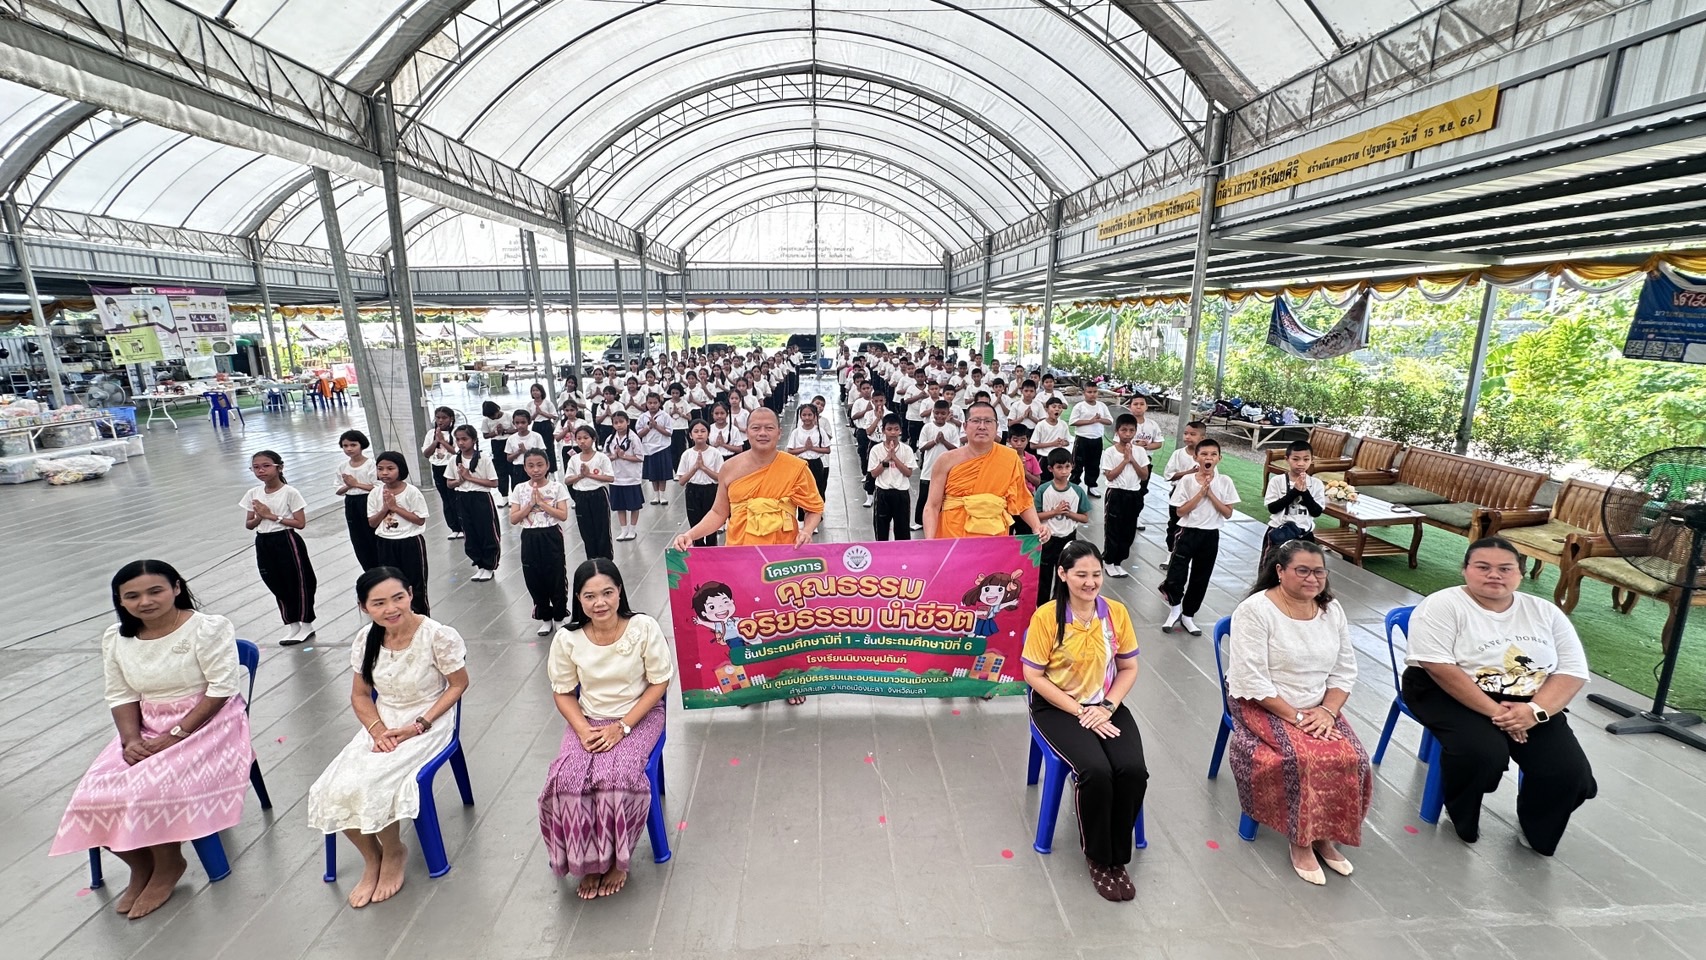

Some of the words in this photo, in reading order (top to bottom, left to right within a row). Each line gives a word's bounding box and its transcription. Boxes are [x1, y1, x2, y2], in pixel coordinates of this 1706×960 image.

[1401, 124, 1419, 145] วันที่
[1424, 128, 1434, 138] 15
[1439, 121, 1455, 134] พ.ย.
[1460, 108, 1482, 127] 66)
[766, 562, 822, 578] โครงการ
[777, 576, 923, 607] คุณธรรม
[738, 606, 871, 639] จริยธรรม
[881, 602, 975, 632] นำชีวิต
[744, 632, 842, 660] ชั้นประถมศึกษาปีที่
[845, 636, 851, 644] 1
[863, 634, 962, 650] ชั้นประถมศึกษาปีที่
[964, 642, 973, 650] 6
[1478, 640, 1501, 652] SAVE
[1515, 635, 1548, 646] HORSE
[806, 653, 908, 665] โรงเรียนนิบงชนูปถัมภ์
